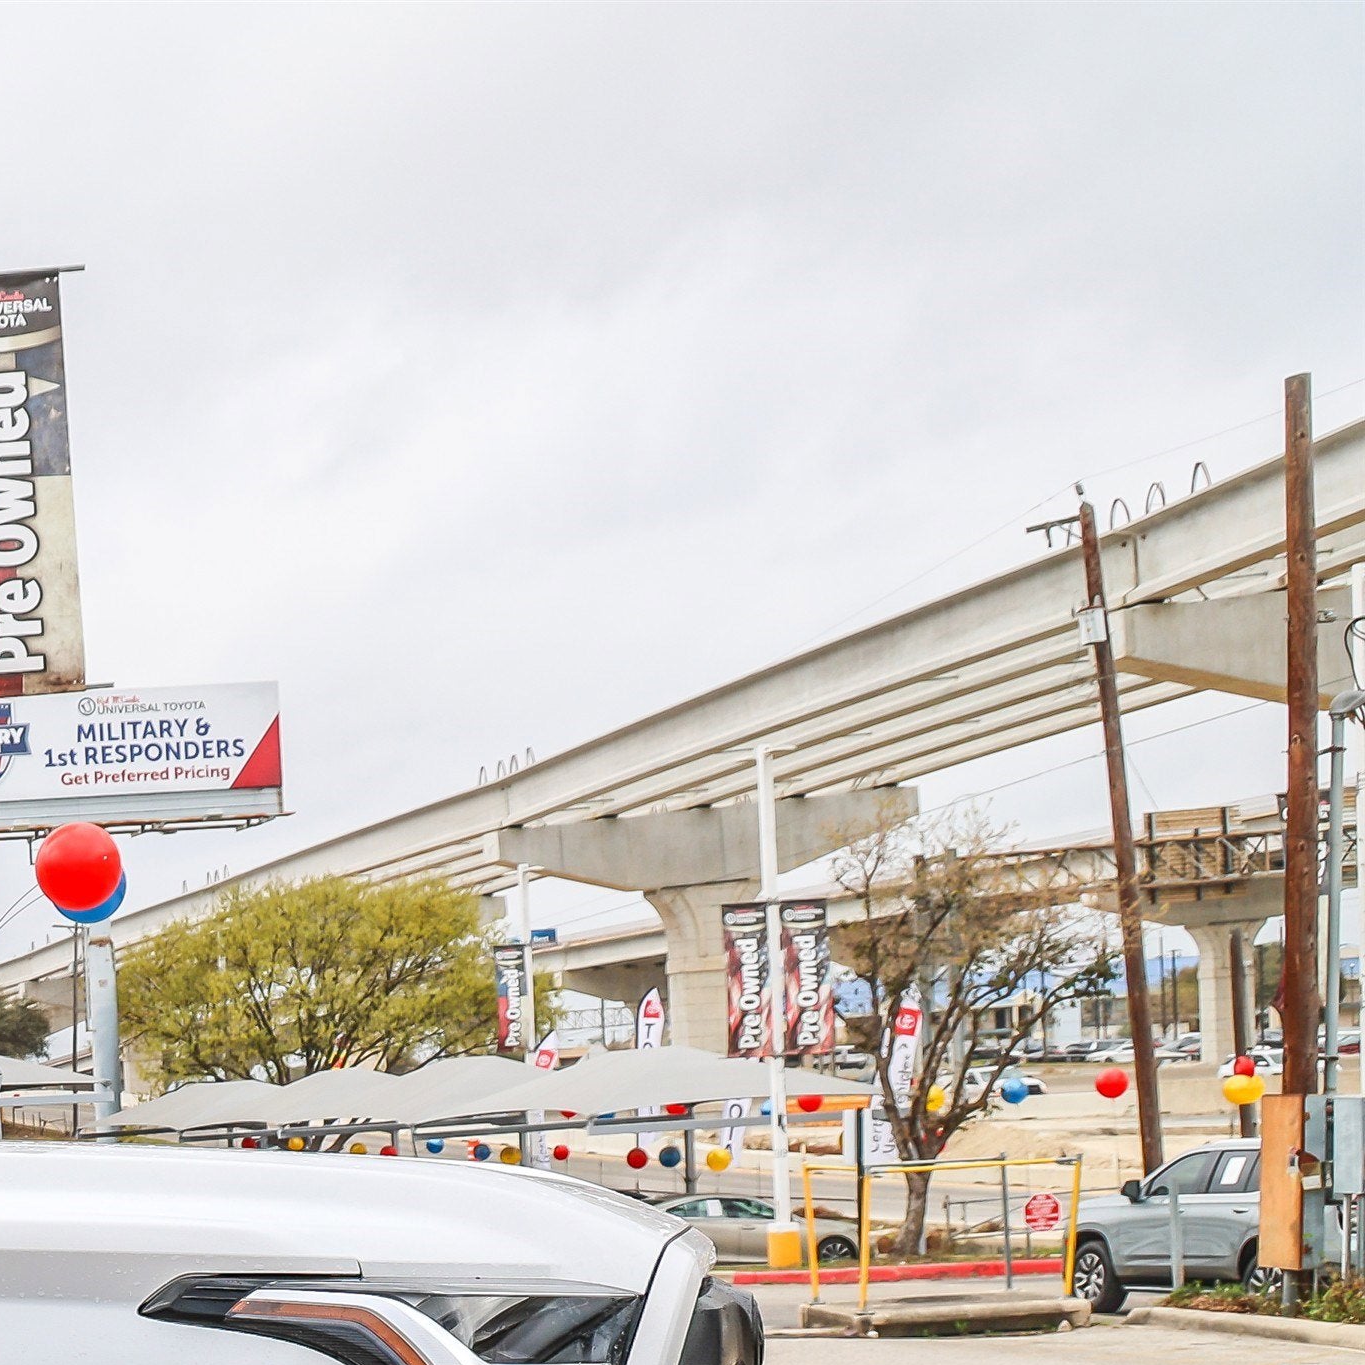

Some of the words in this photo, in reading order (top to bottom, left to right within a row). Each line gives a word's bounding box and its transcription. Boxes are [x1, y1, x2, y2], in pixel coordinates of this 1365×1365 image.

[97, 702, 160, 715] UNIVERSAL
[164, 700, 206, 712] TOYOTA
[77, 718, 189, 743] MILITARY
[195, 716, 211, 737] &
[44, 747, 78, 768] 1st
[84, 738, 246, 765] RESPONDERS
[61, 773, 90, 786] Get
[94, 767, 170, 784] Preferred
[174, 765, 231, 781] Pricing
[733, 938, 761, 1011] Owned
[791, 934, 820, 1008] Owned
[738, 1011, 762, 1050] Pre
[796, 1009, 821, 1046] Pre
